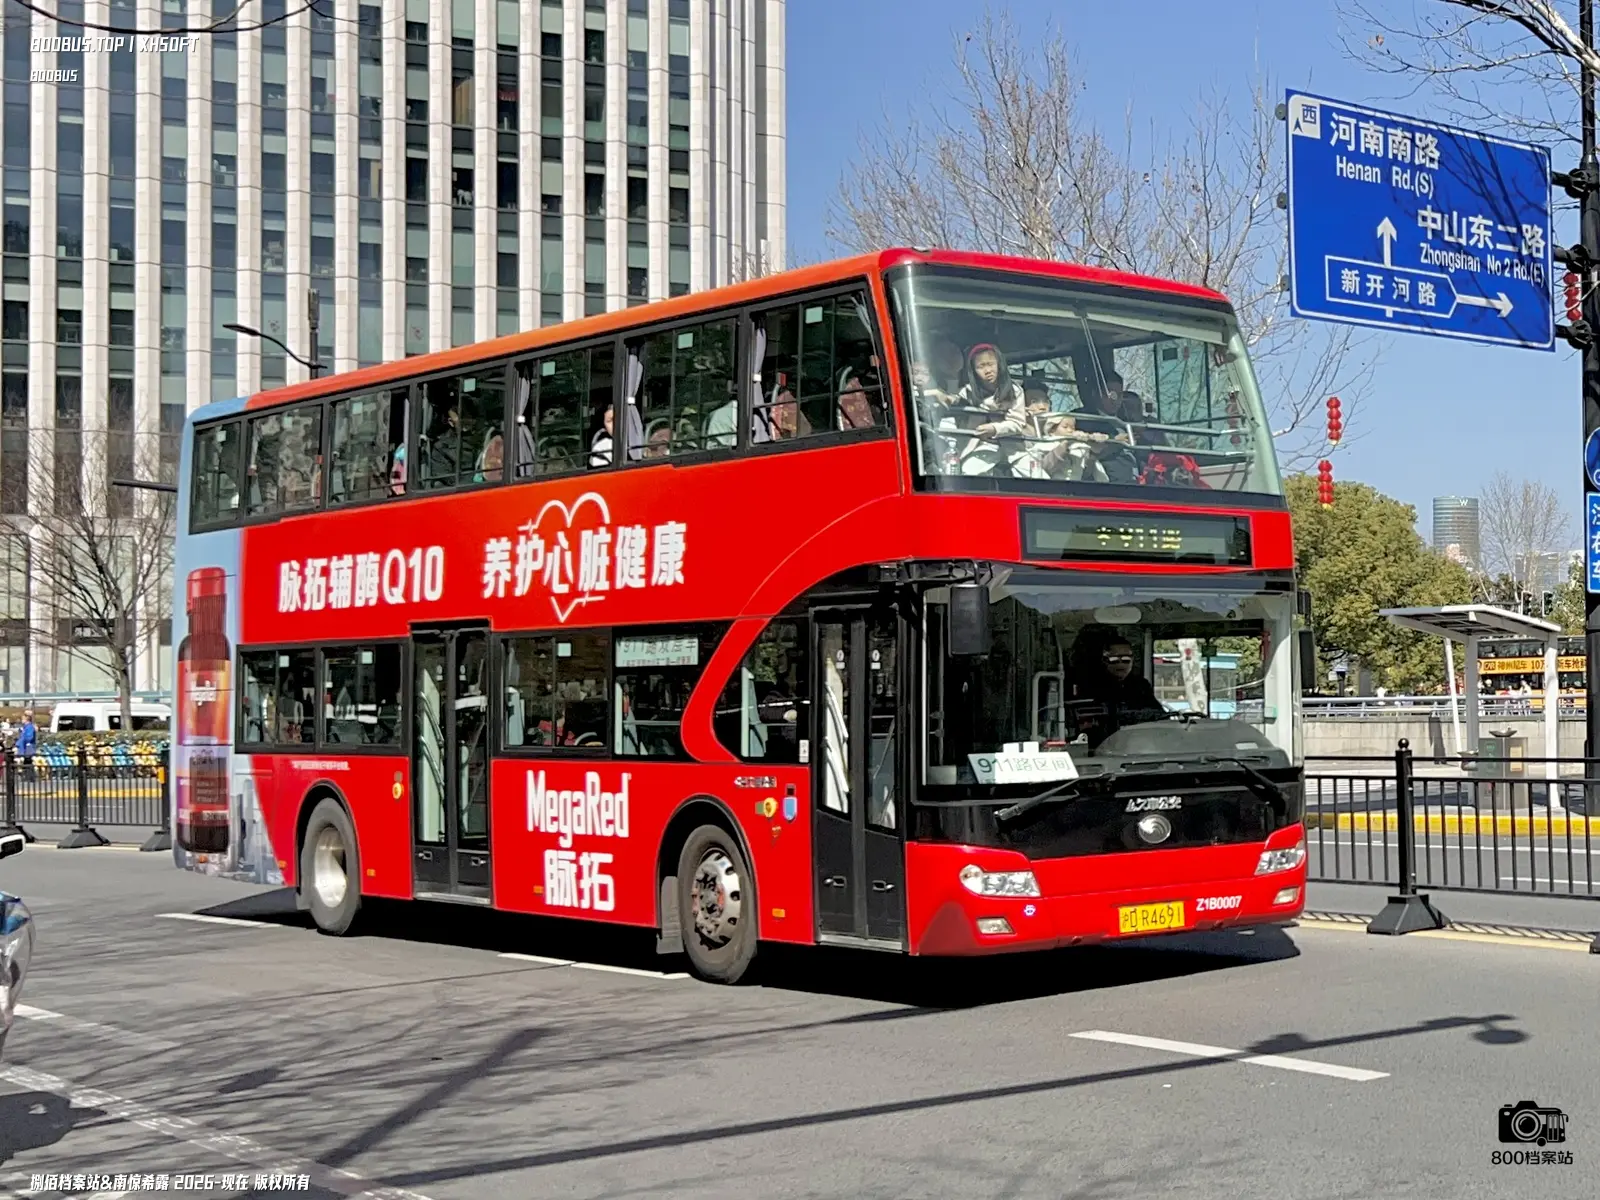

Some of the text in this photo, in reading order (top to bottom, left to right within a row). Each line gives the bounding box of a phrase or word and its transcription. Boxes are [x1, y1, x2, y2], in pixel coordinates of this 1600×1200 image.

[1302, 104, 1317, 125] 西
[1329, 111, 1441, 170] 河南南路
[1336, 154, 1434, 199] Henan Rd.(S)
[1417, 204, 1546, 260] 中山东二路
[1340, 267, 1437, 308] 新开河路
[1420, 243, 1481, 274] Zhongshan
[1513, 261, 1545, 289] Rd.(E)
[277, 520, 688, 614] 脉拓辅酶Q10 养护心脏健康
[977, 757, 1071, 774] 911路区间
[544, 849, 615, 911] 脉拓
[1195, 895, 1242, 912] Z1B0007
